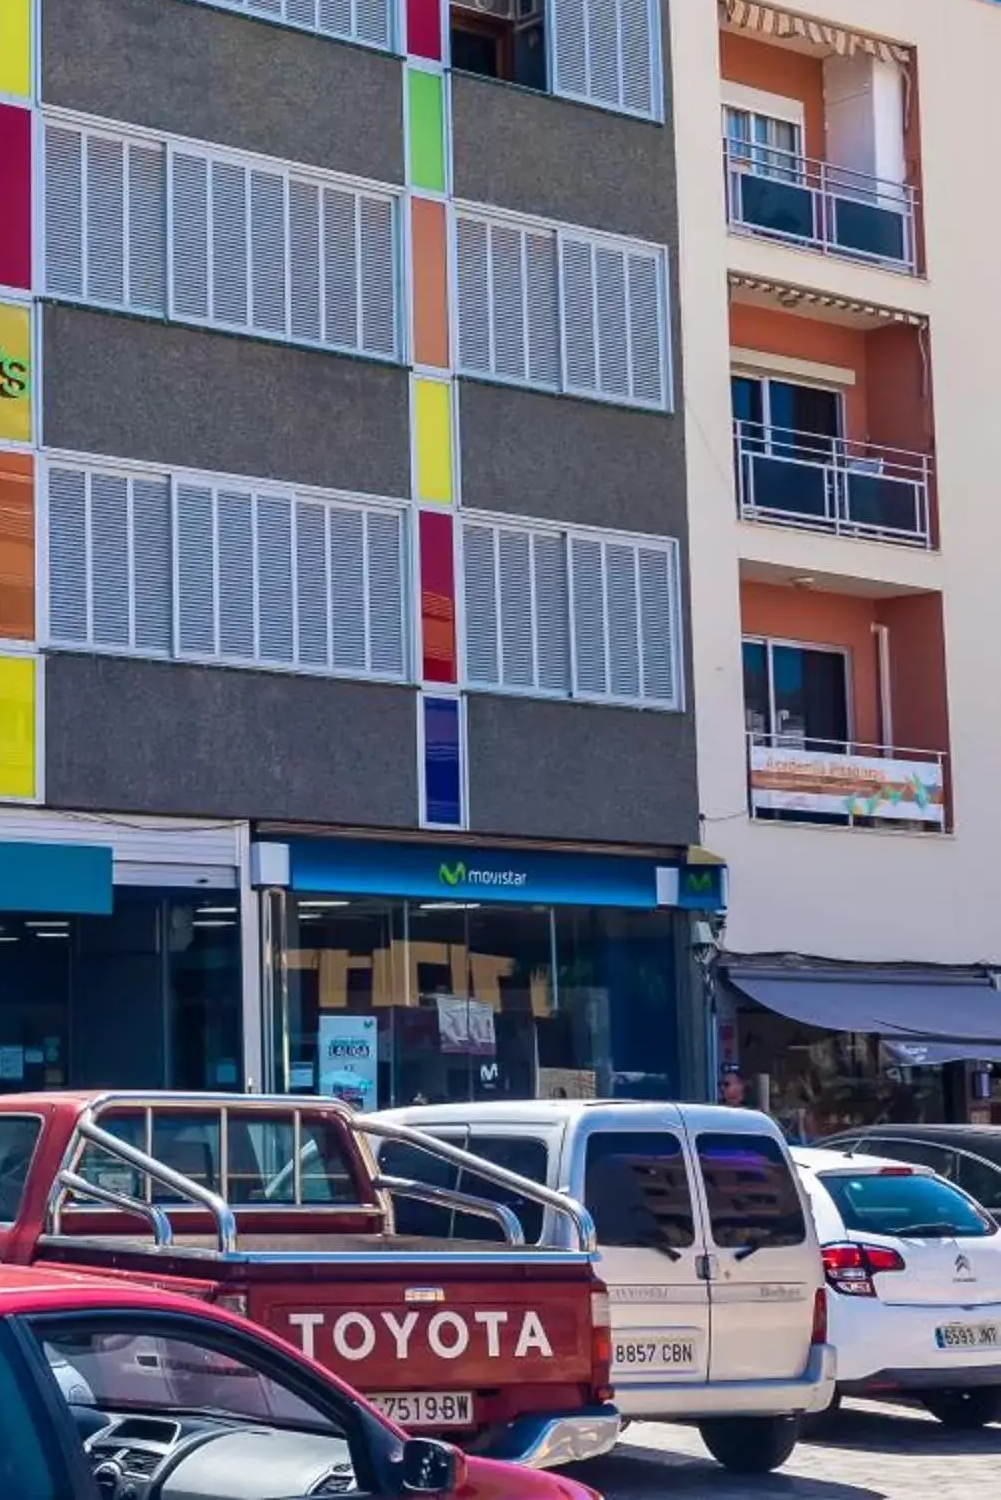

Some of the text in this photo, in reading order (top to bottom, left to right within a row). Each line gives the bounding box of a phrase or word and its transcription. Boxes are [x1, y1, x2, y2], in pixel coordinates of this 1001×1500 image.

[467, 869, 528, 886] movistar
[288, 1311, 554, 1361] TOYOTA
[615, 1344, 693, 1363] 8857 CBN
